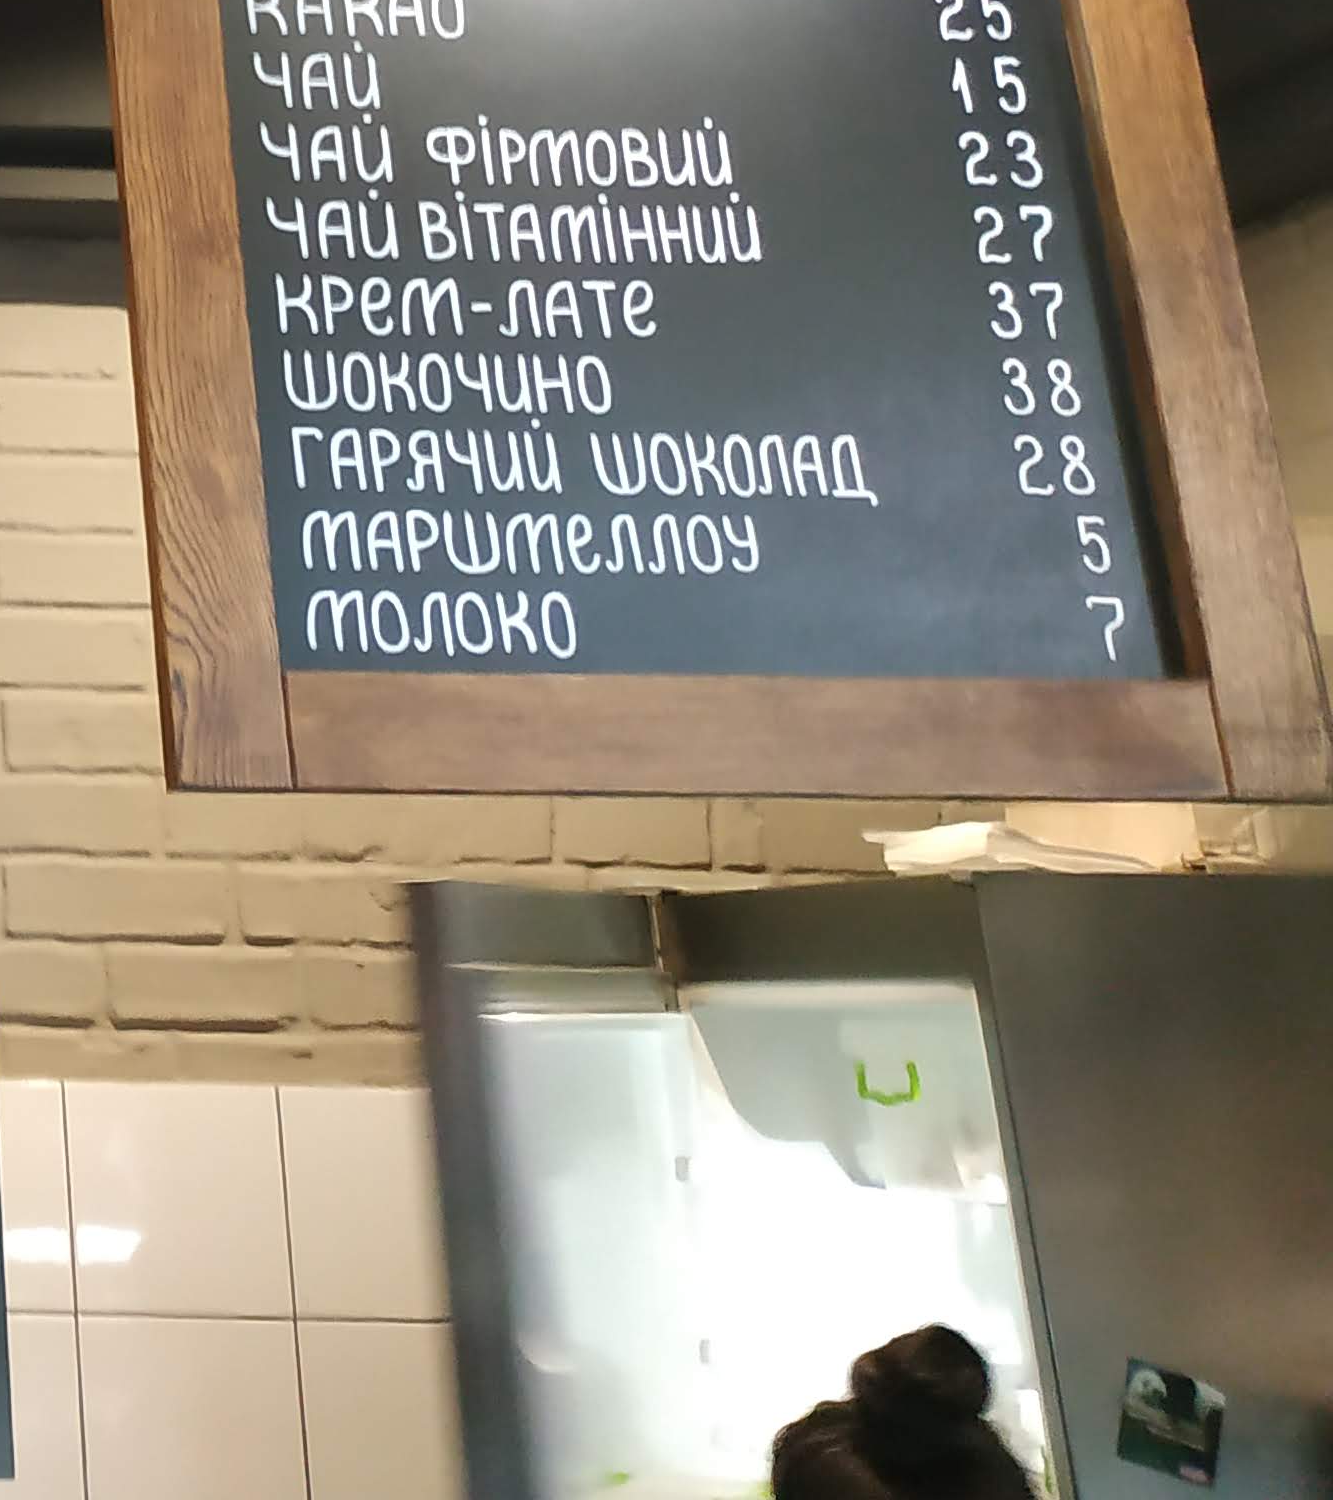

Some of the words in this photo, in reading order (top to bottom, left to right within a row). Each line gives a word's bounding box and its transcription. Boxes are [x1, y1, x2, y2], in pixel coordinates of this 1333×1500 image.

[253, 41, 380, 110] ЧАЙ
[951, 55, 1028, 114] 15
[260, 114, 393, 183] ЧАЙ
[426, 115, 734, 188] ФІРМОВИЙ
[958, 130, 1043, 188] 23
[265, 189, 400, 261] ЧАЙ
[418, 190, 763, 263] ВІТАМІННИЙ
[973, 205, 1055, 263] 27
[275, 274, 657, 339] КРЕМ-ЛАТЕ
[988, 280, 1064, 339] 37
[282, 349, 612, 414] ШОКОЧИНО
[1002, 357, 1082, 417] 38
[291, 418, 562, 494] ГАРЯЧИЙ
[589, 430, 878, 507] ШОКОЛАД
[1013, 434, 1097, 497] 28
[302, 509, 760, 575] МАРШМЕЛЛОУ
[1077, 515, 1111, 574] 5
[306, 589, 577, 659] МОЛОКО
[1085, 595, 1124, 662] 7
